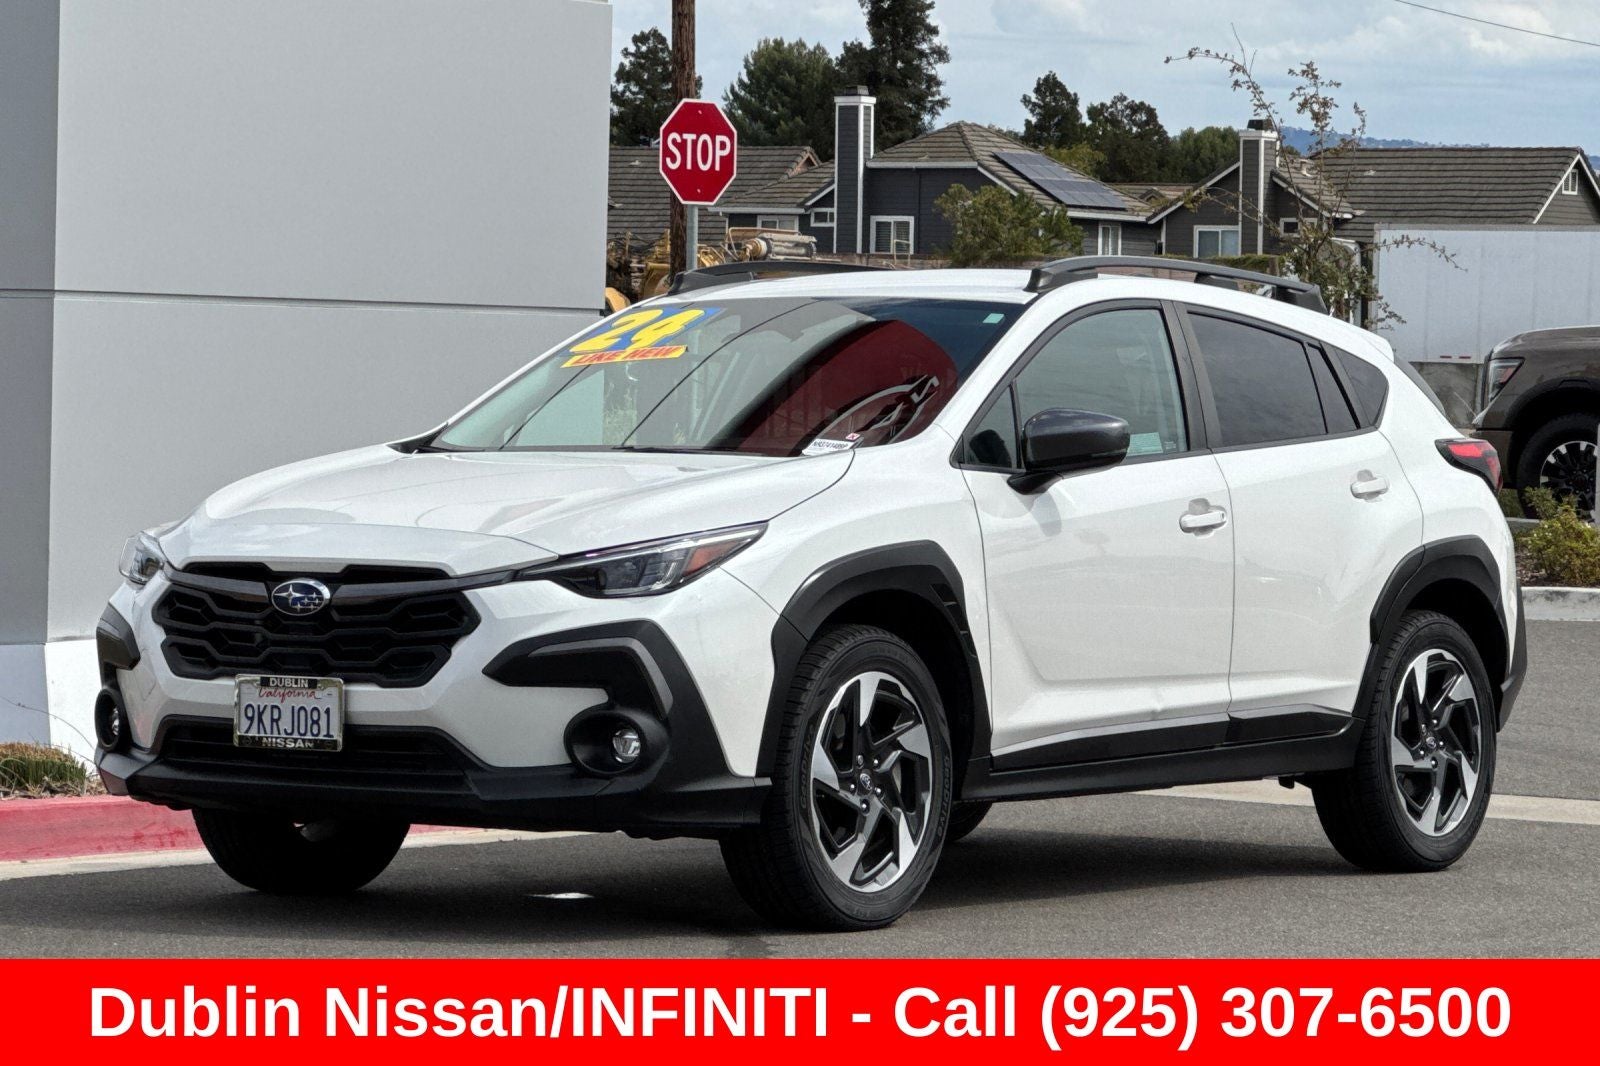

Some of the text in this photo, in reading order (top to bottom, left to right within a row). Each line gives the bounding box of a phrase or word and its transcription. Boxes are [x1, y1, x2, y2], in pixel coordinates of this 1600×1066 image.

[665, 132, 731, 171] STOP
[569, 309, 705, 353] 24
[259, 687, 321, 703] California
[269, 677, 309, 688] DUBLIN
[243, 703, 334, 738] 9KRJ081
[261, 737, 314, 748] NISSAN
